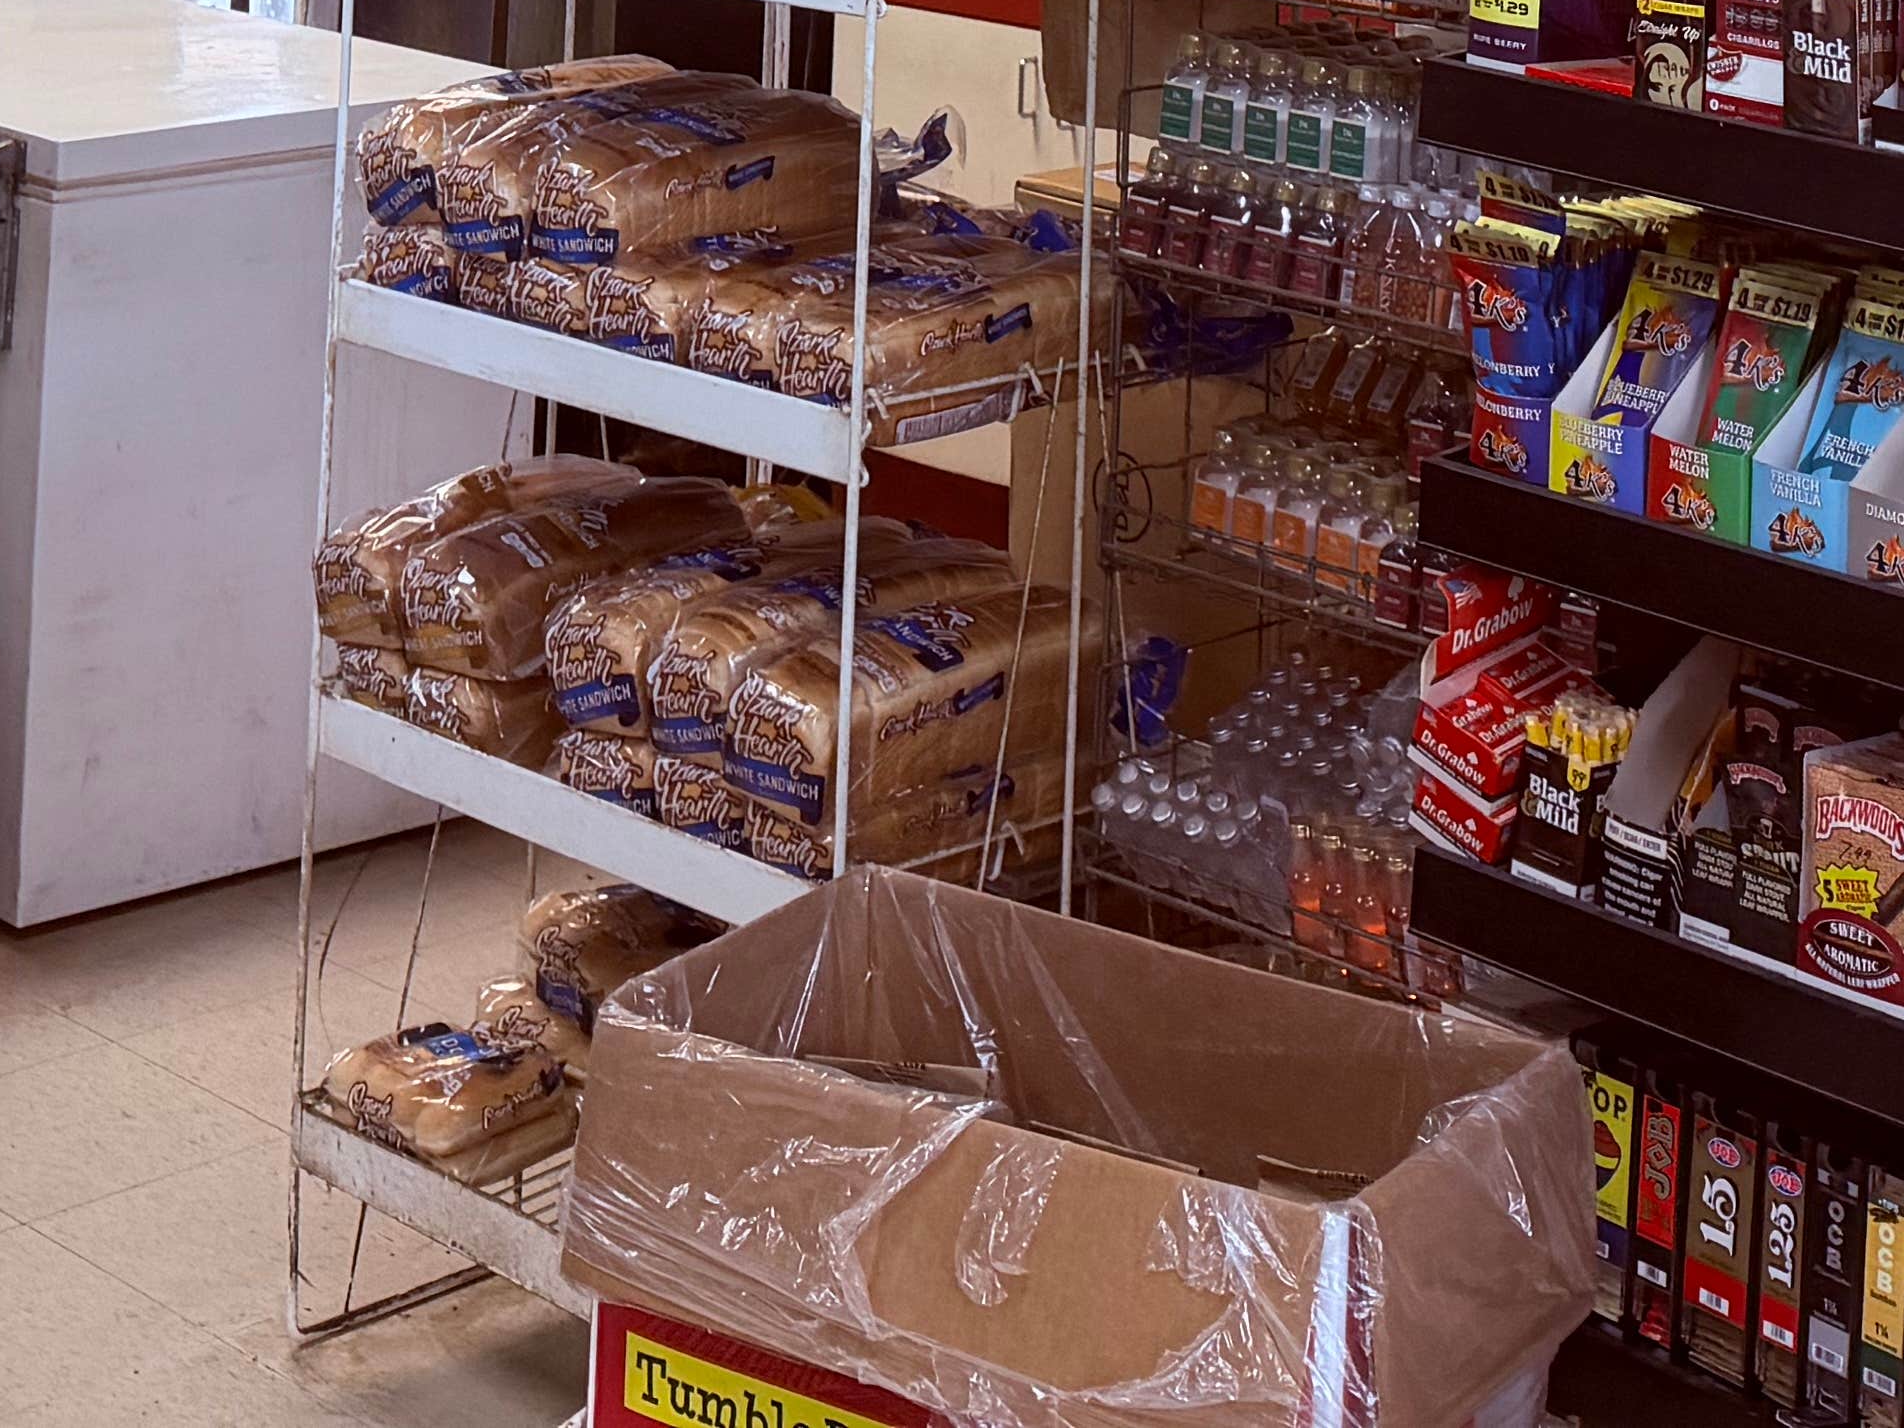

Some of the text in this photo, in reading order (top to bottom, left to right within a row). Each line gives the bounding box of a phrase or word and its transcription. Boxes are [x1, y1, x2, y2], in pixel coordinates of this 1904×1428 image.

[1793, 31, 1851, 61] Black
[1803, 56, 1851, 84] Mild
[558, 234, 614, 254] SANDWICH
[1669, 445, 1709, 466] WATER
[1669, 458, 1709, 480] MELON
